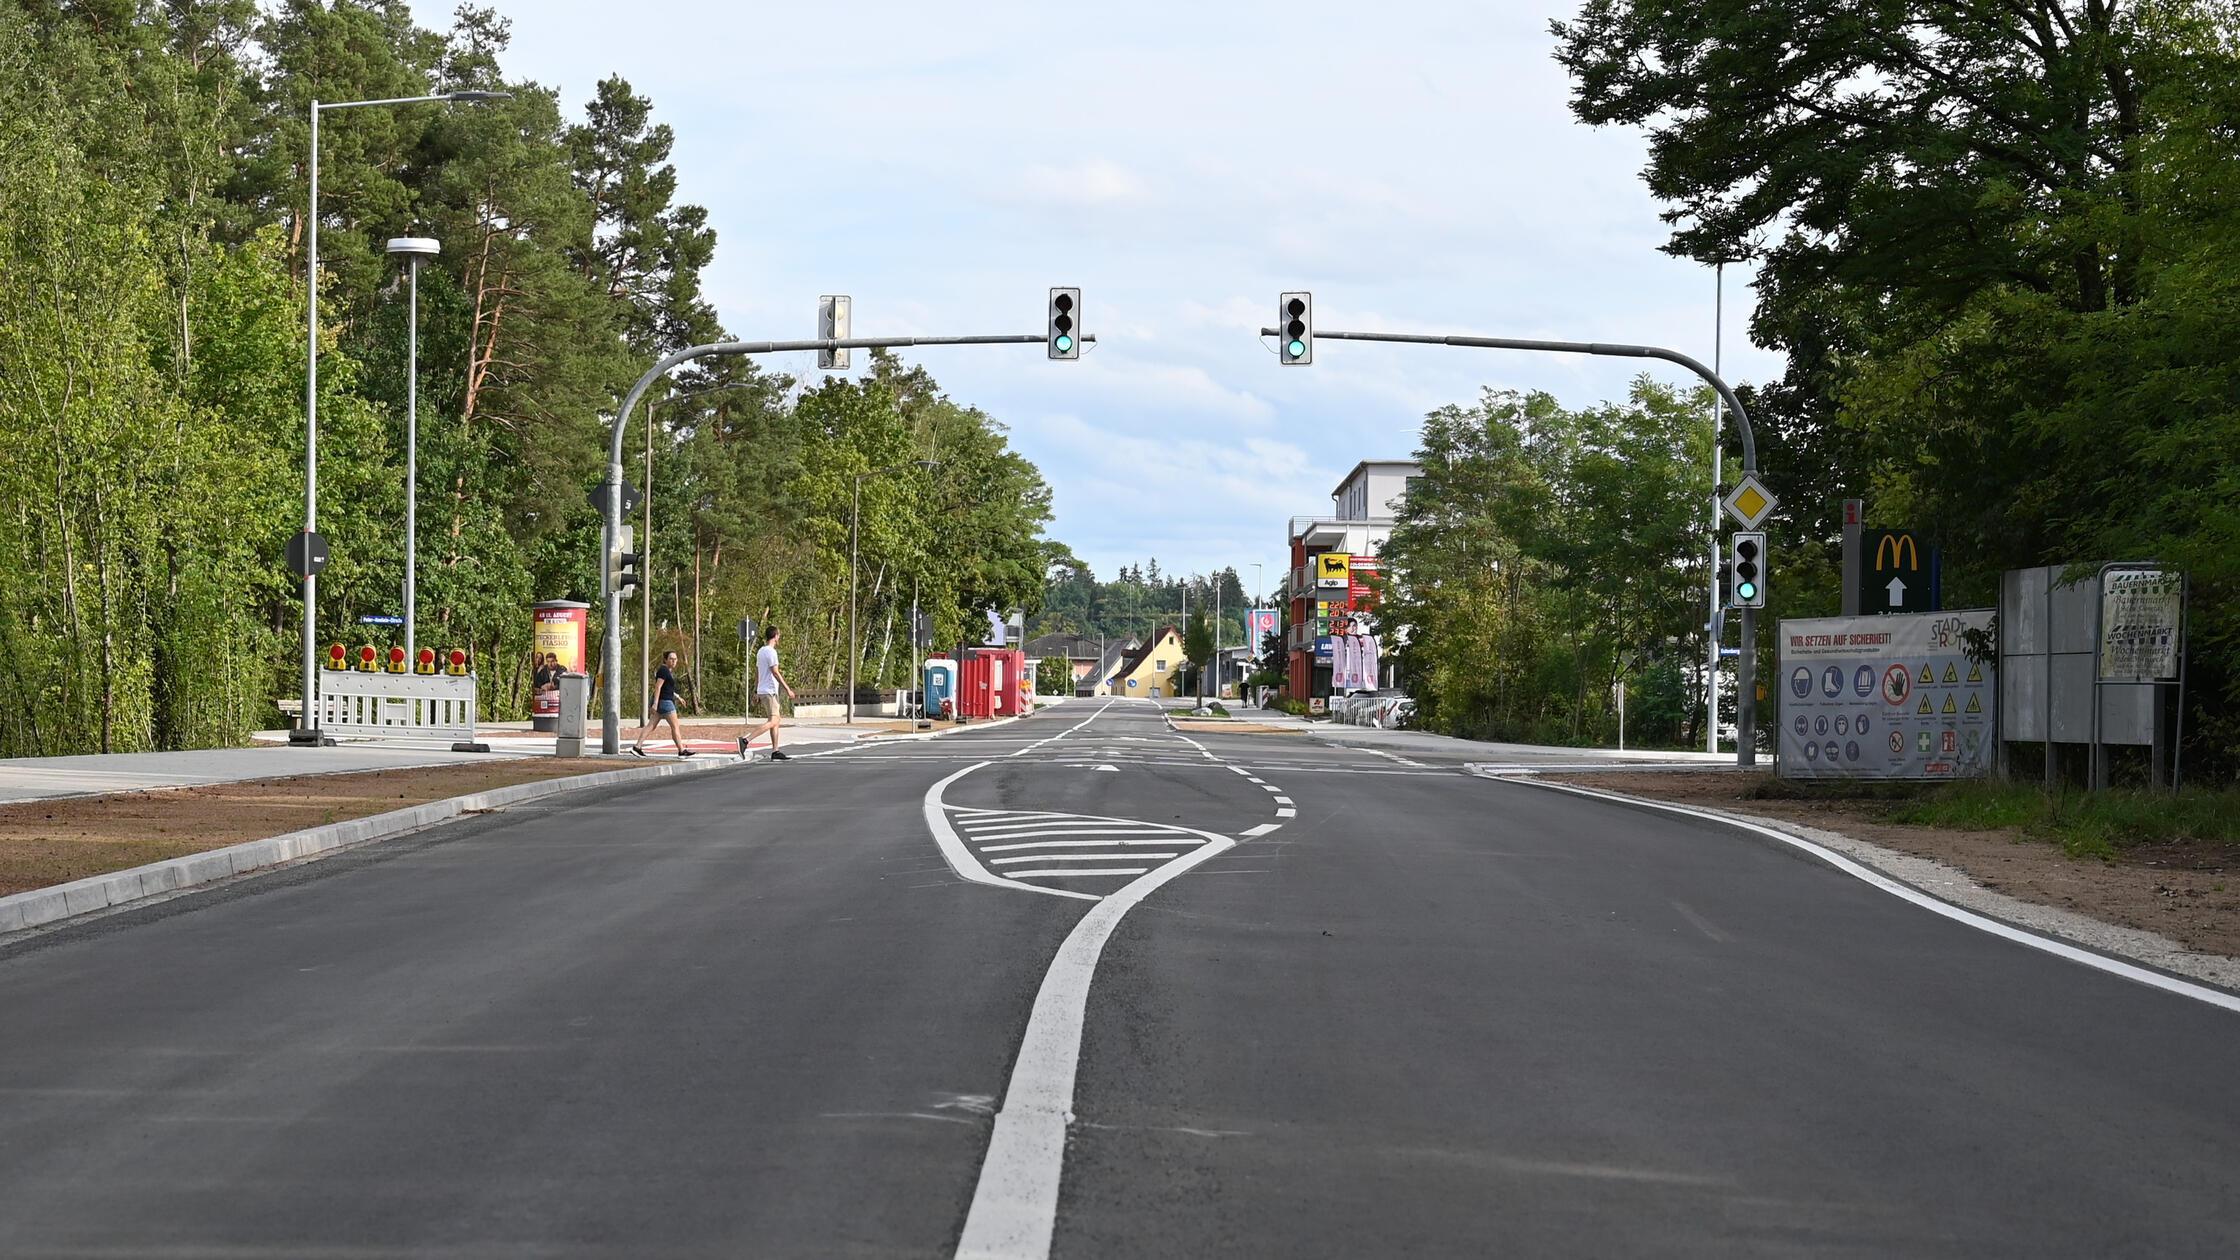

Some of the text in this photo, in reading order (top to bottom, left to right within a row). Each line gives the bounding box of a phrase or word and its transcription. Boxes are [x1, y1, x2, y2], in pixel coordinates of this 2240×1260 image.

[1931, 617, 1967, 640] STADT
[2107, 627, 2173, 639] WOCHENMARKT
[1790, 632, 1892, 647] WIR SETZEN AUF SICHERHEIT!
